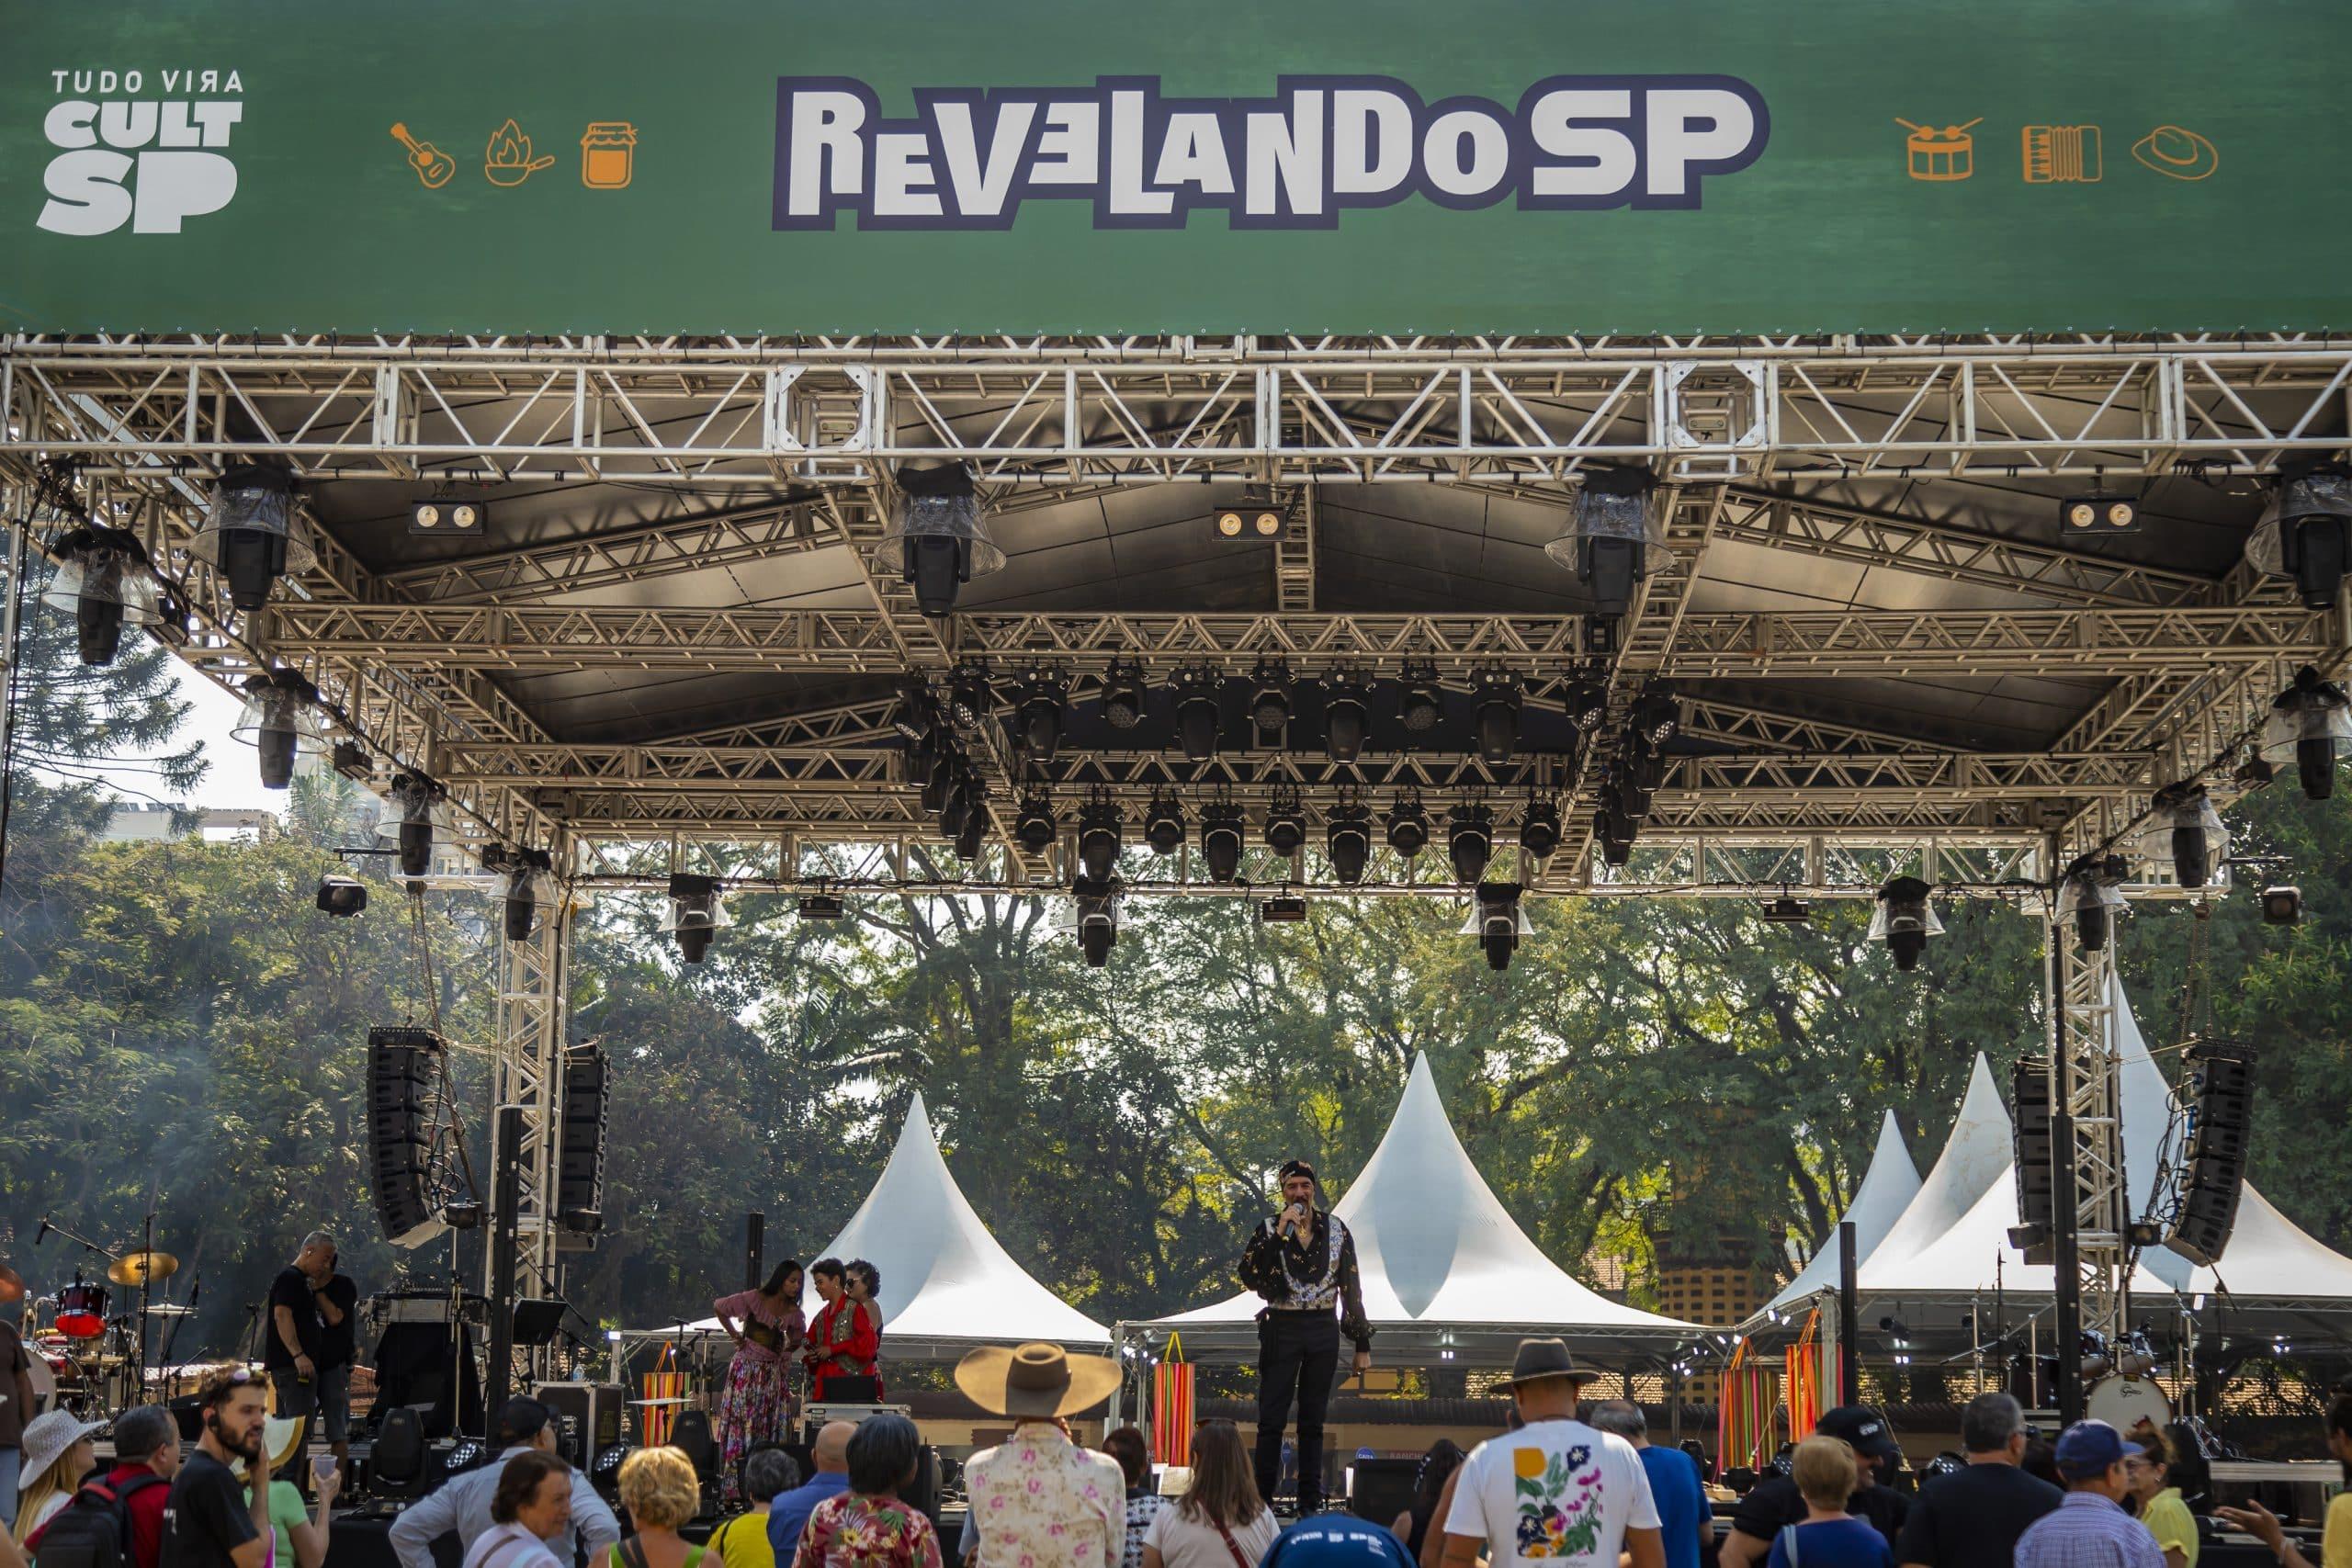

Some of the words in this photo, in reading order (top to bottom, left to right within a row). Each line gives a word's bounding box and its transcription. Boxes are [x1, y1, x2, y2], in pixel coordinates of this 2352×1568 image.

[51, 70, 142, 93] TUDO
[161, 70, 243, 93] VIRA
[44, 100, 243, 149] CULT
[36, 149, 238, 236] SP
